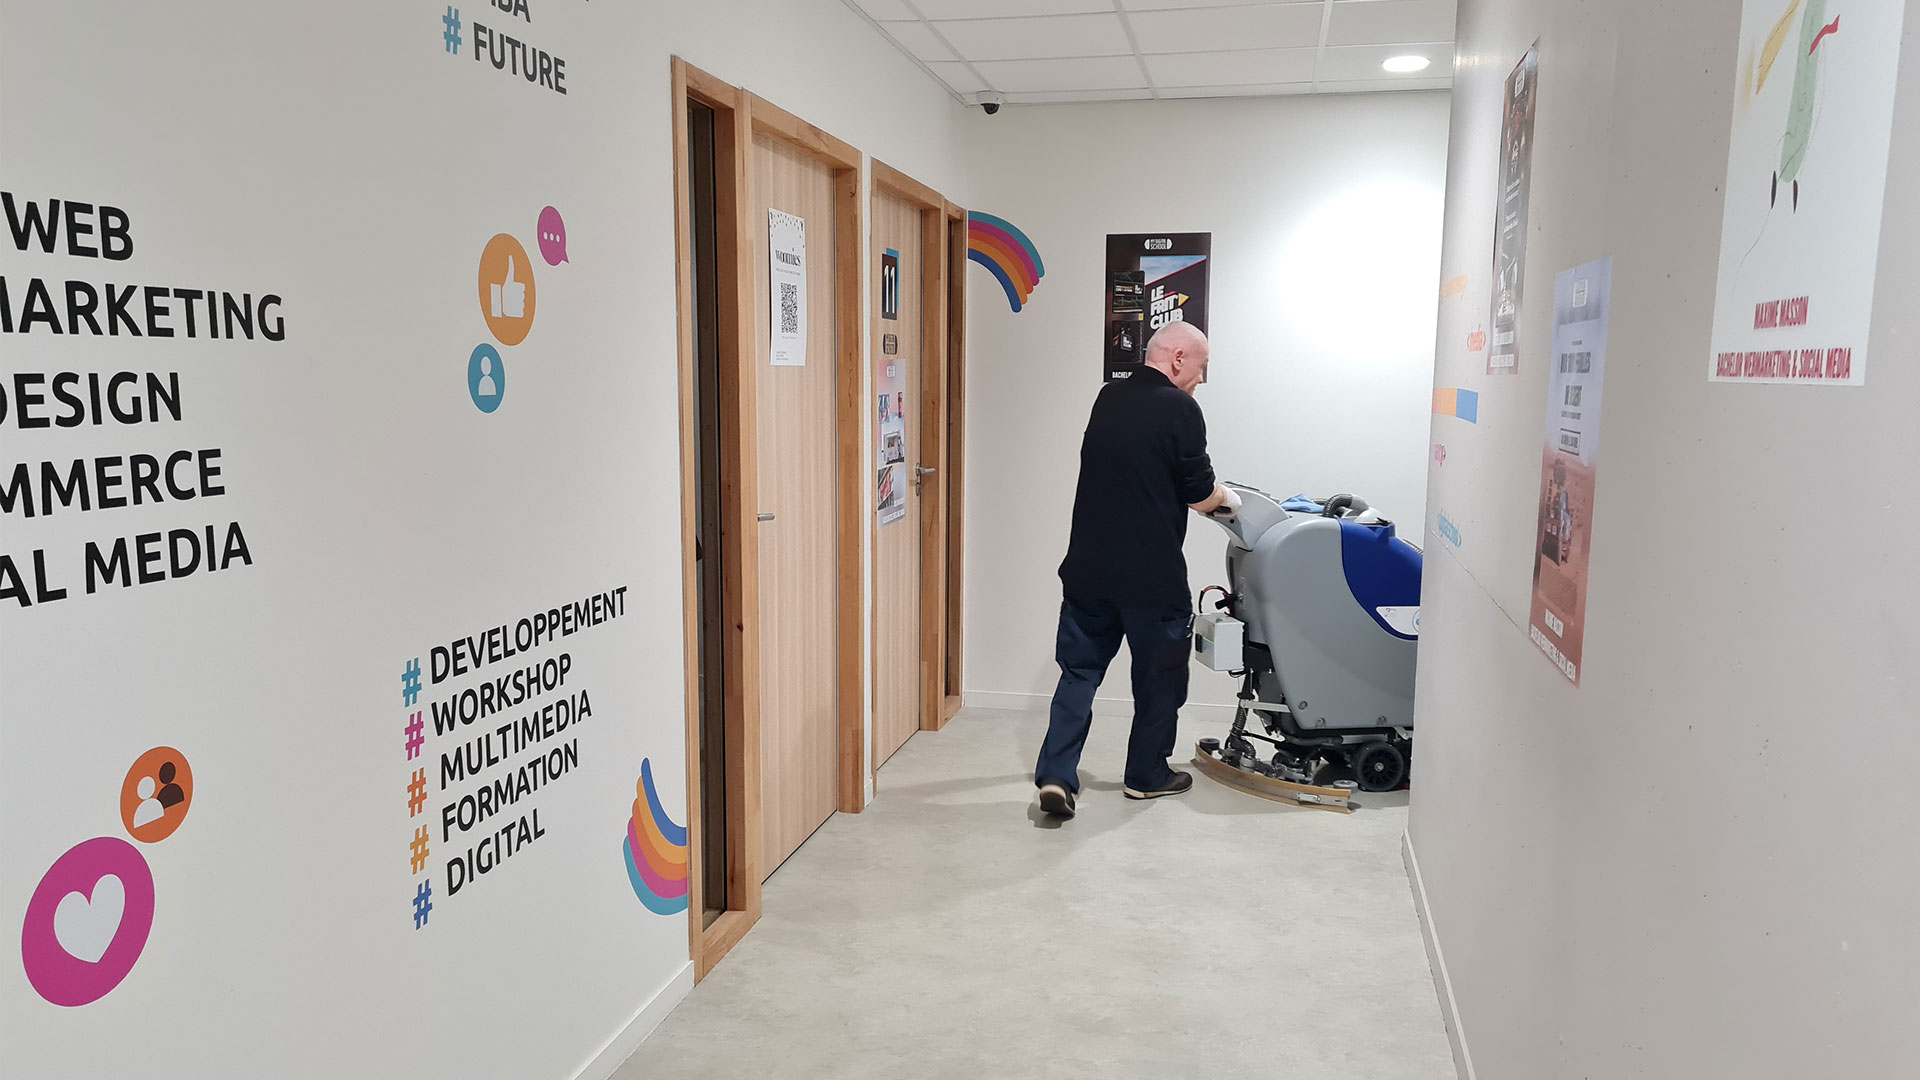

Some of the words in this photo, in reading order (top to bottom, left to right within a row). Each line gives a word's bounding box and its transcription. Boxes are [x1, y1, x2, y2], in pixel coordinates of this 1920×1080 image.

[473, 22, 567, 95] FUTURE
[0, 191, 134, 261] WEB
[0, 276, 286, 341] ARKETING
[883, 264, 896, 315] 11
[1150, 294, 1179, 316] FRIT
[1150, 308, 1184, 330] CLUB
[1151, 284, 1165, 301] LE
[1799, 349, 1824, 378] SOCIAL
[1825, 347, 1851, 379] MEDIA
[0, 371, 182, 429] ESIGN
[86, 522, 253, 595] MEDIA
[430, 586, 627, 685] DEVELOPPEMENT
[431, 653, 572, 737] WORKSHOP
[441, 689, 592, 791] MULTIMEDIA
[442, 738, 578, 843] FORMATION
[447, 808, 546, 897] DIGITAL
